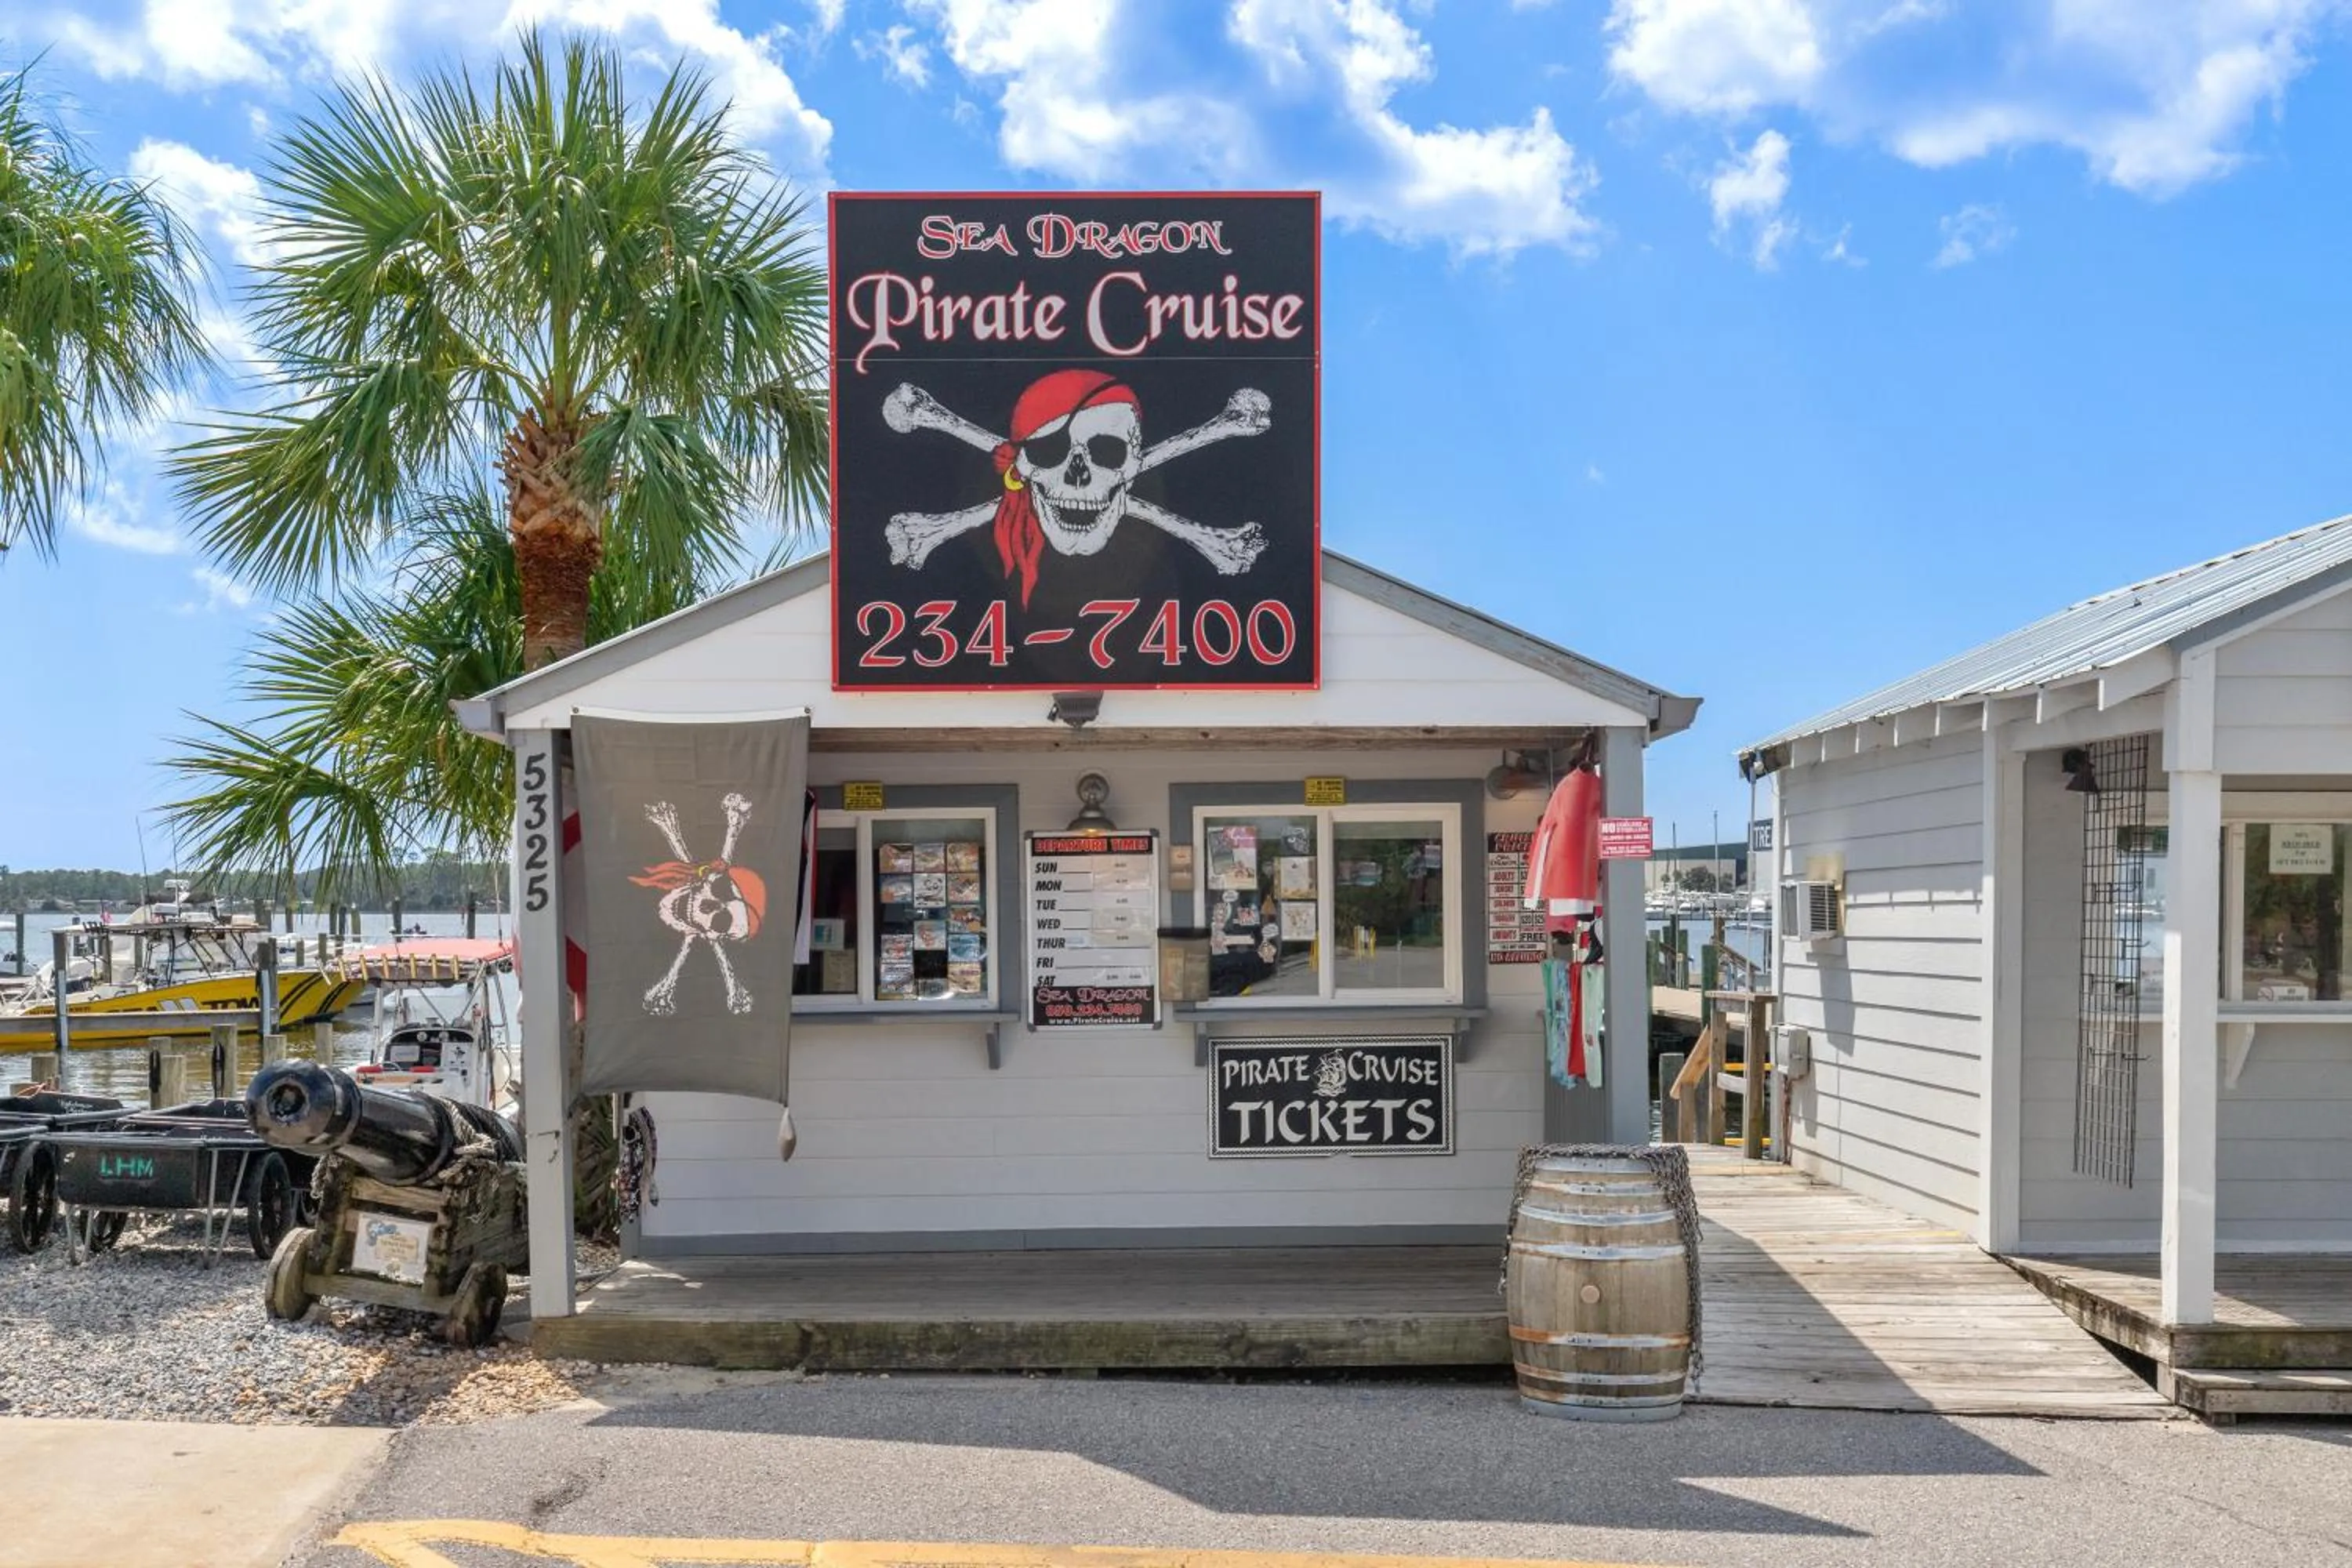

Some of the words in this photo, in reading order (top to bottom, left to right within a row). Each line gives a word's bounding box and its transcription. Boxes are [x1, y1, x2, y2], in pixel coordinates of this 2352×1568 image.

[847, 271, 1067, 374] Pirate
[1087, 271, 1305, 358] Cruise
[856, 598, 1296, 670] 234-7400
[523, 752, 549, 912] 5325
[1035, 862, 1058, 874] SUN
[1035, 880, 1062, 891] MON
[1036, 899, 1058, 910] TUE
[1036, 918, 1061, 930] WED
[1521, 932, 1544, 942] FREE
[1036, 938, 1066, 949] THUR
[1036, 956, 1054, 968] FRI
[1036, 975, 1056, 987] SAT
[1222, 1054, 1310, 1090] PIRATE
[1347, 1051, 1439, 1086] CRUISE
[1227, 1098, 1436, 1145] TICKETS
